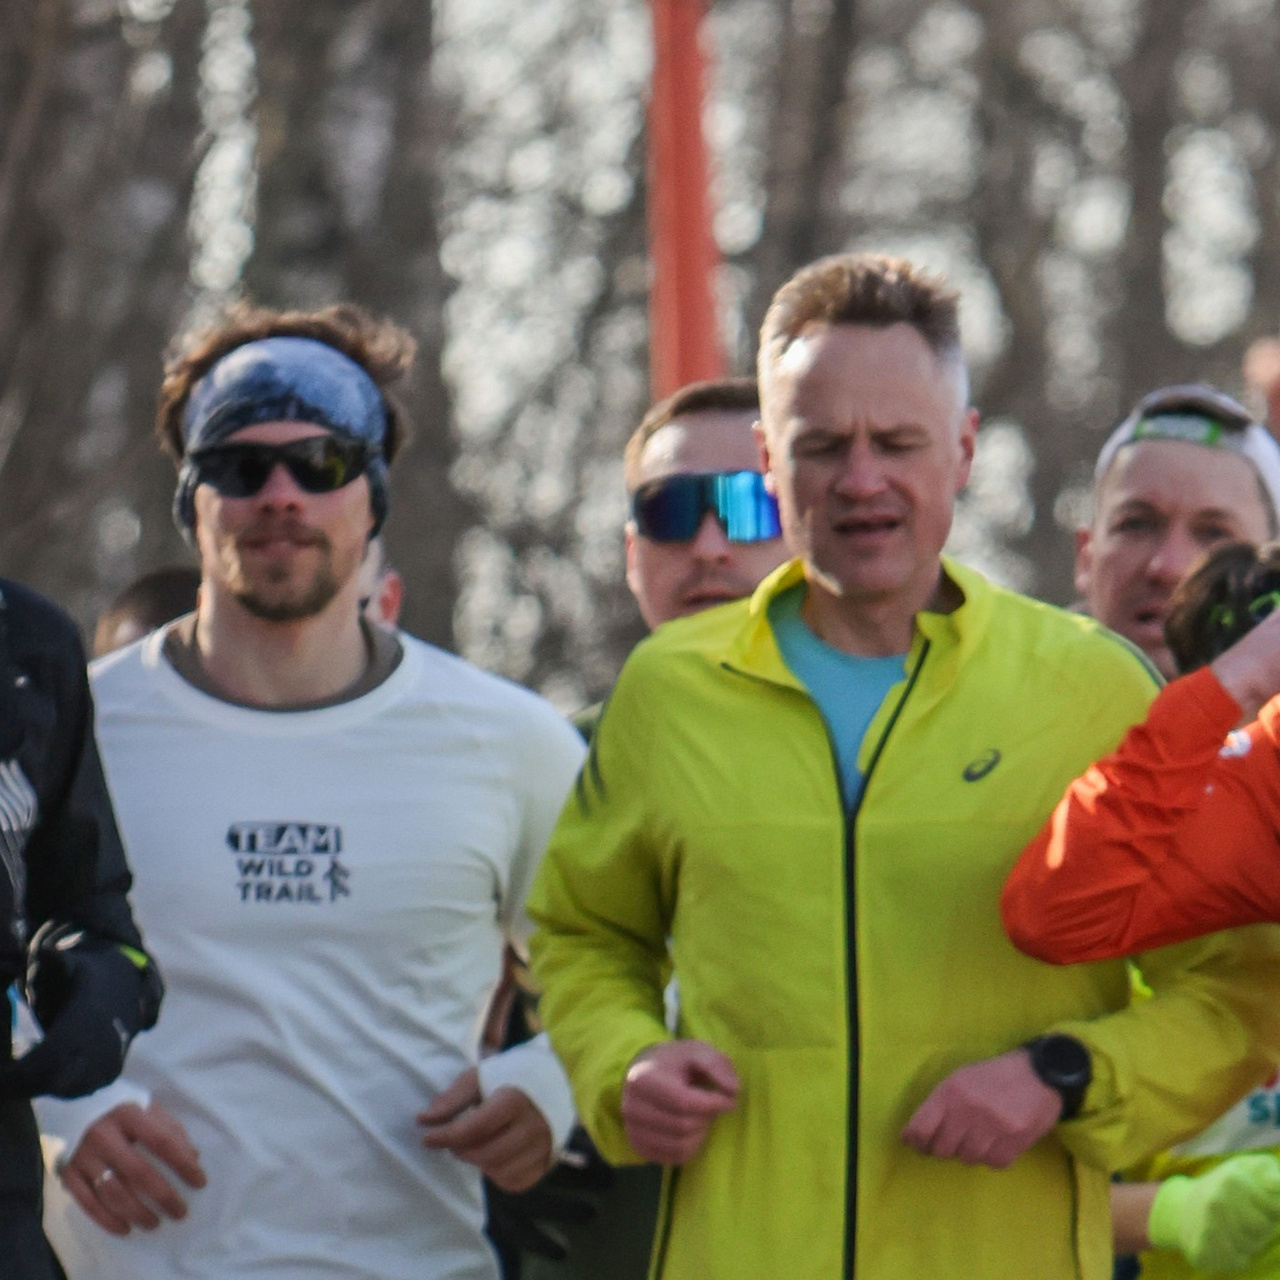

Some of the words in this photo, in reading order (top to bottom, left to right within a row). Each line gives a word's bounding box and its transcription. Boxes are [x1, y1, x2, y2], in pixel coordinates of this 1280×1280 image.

[236, 823, 338, 854] TEAM
[236, 858, 315, 877] WILD
[237, 881, 322, 903] TRAIL
